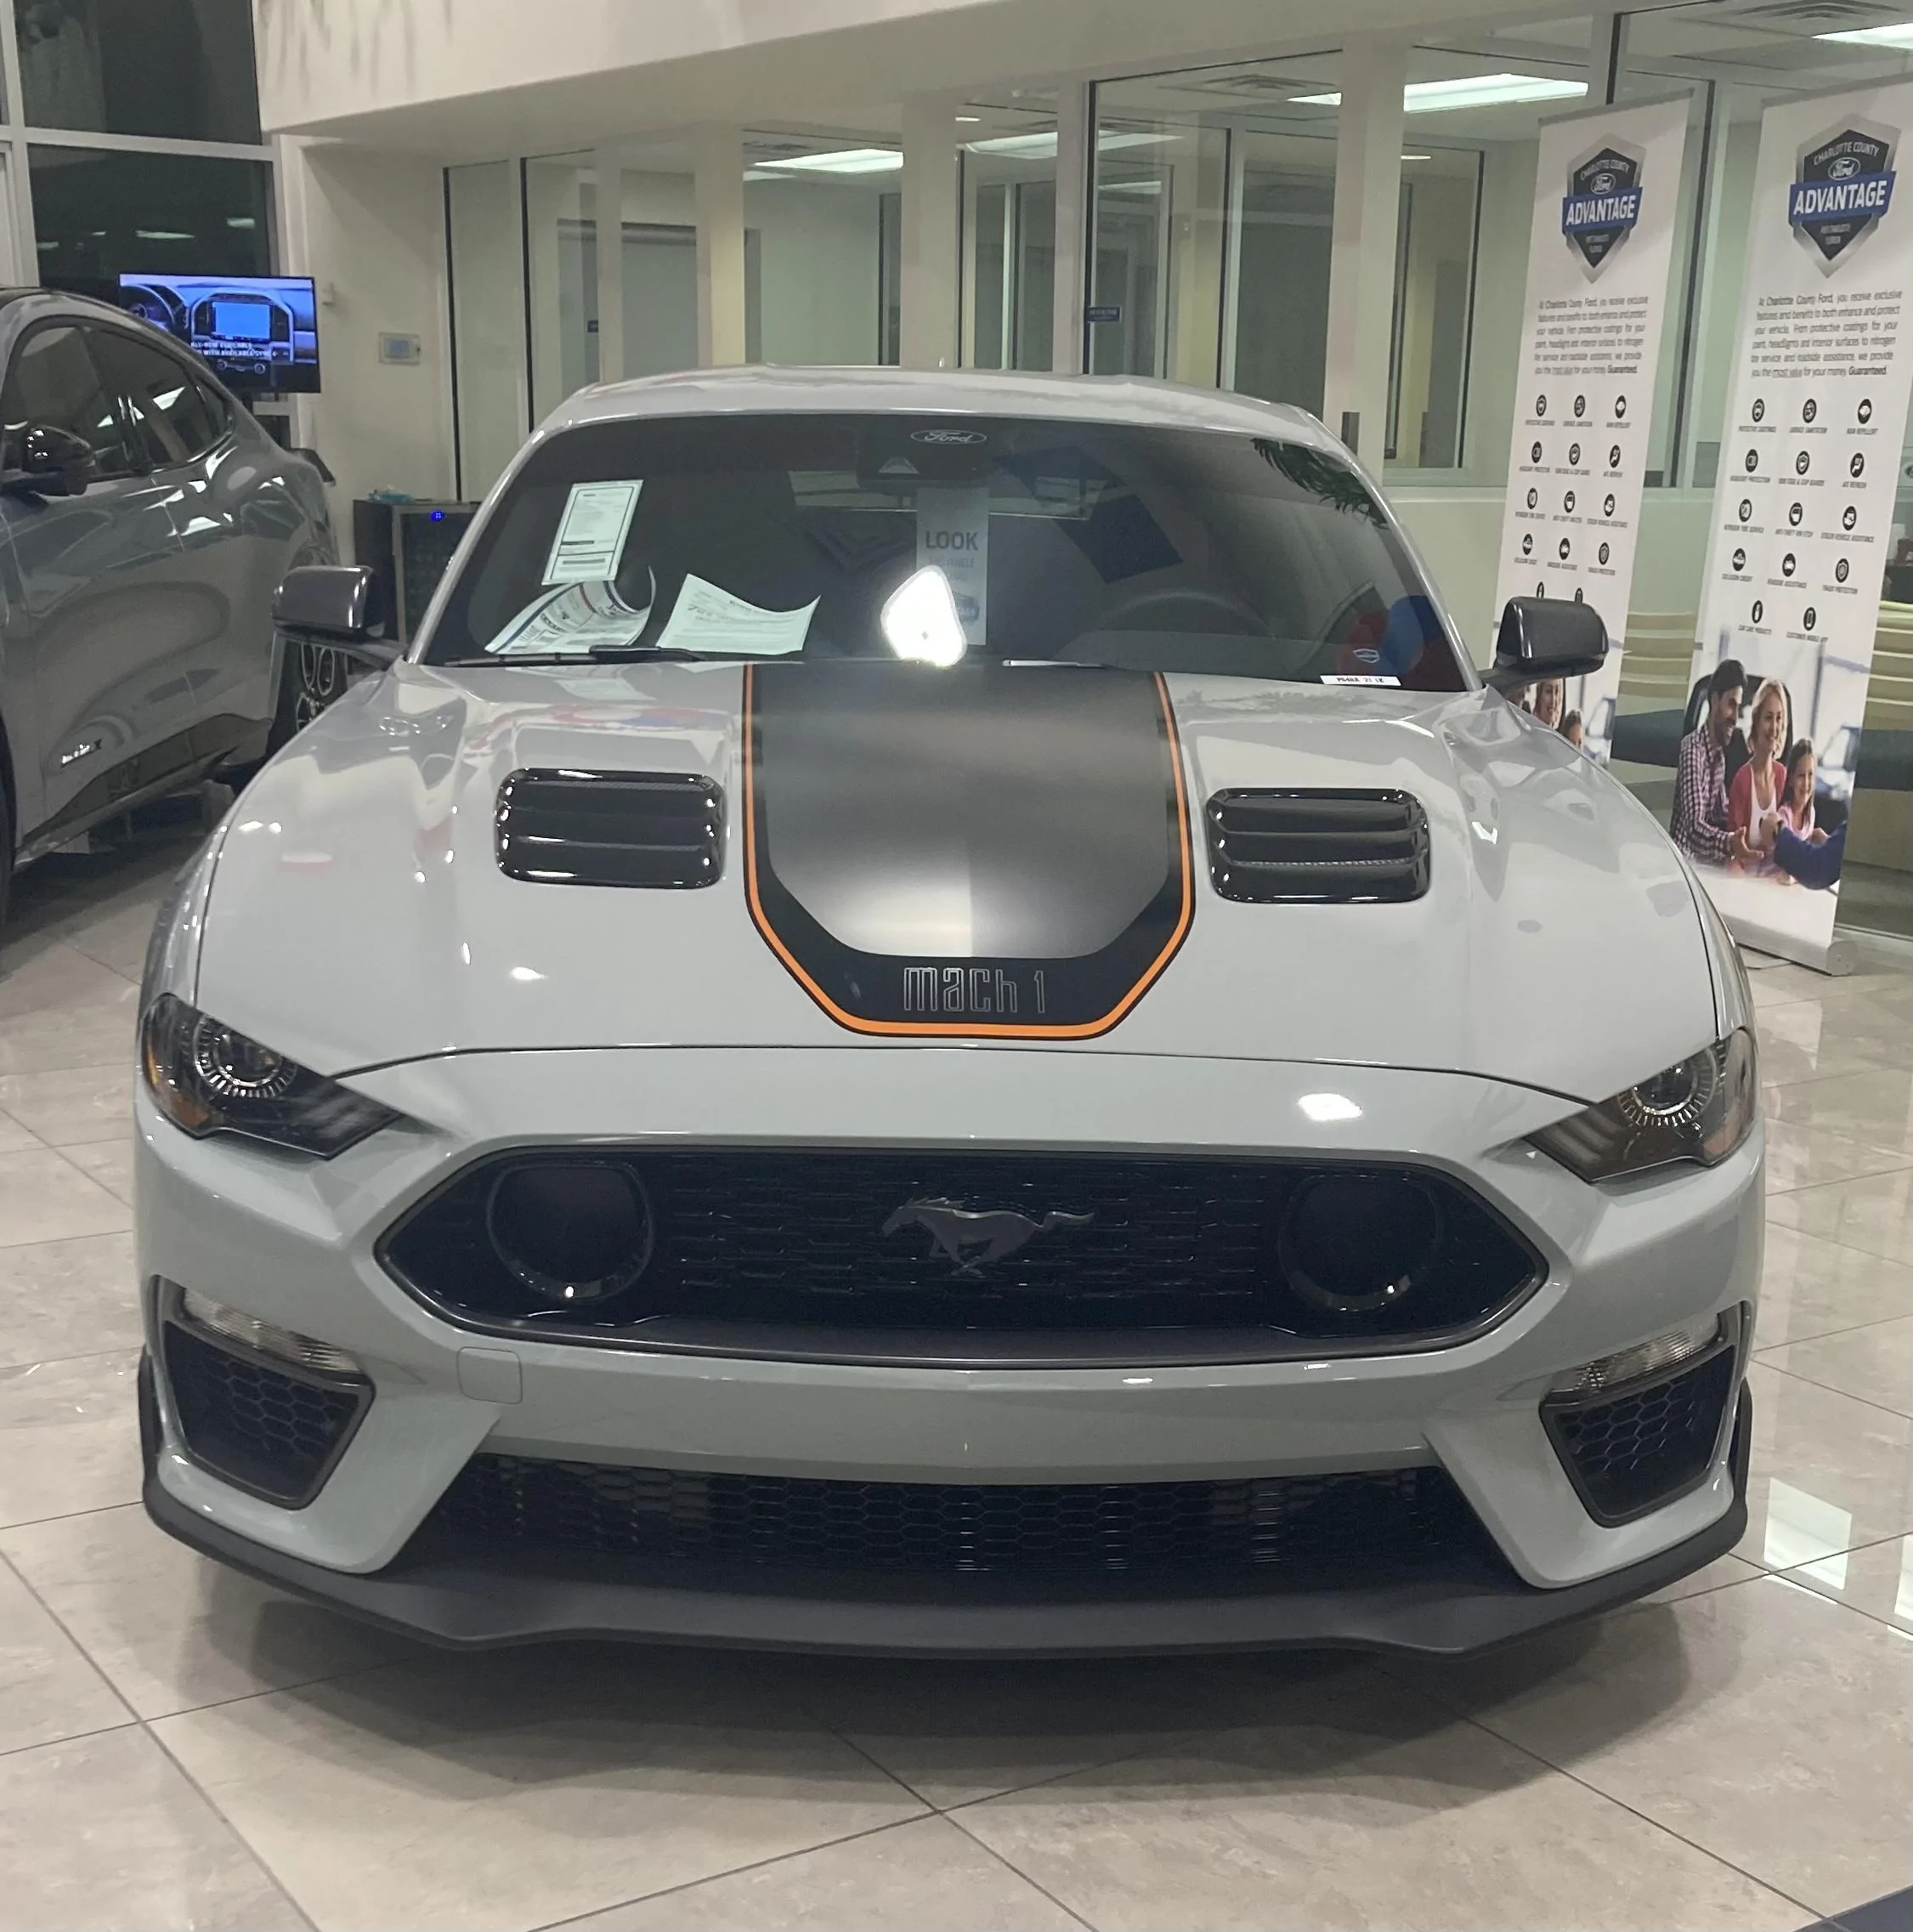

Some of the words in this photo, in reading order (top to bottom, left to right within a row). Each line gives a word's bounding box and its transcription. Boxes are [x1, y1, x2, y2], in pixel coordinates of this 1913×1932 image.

[1814, 142, 1853, 166] CHARLOTTE
[1853, 141, 1881, 157] COUNTY
[1565, 195, 1637, 226] ADVANTAGE
[1793, 180, 1888, 216] ADVANTAGE
[925, 530, 978, 551] LOOK
[1033, 970, 1046, 1013] 1
